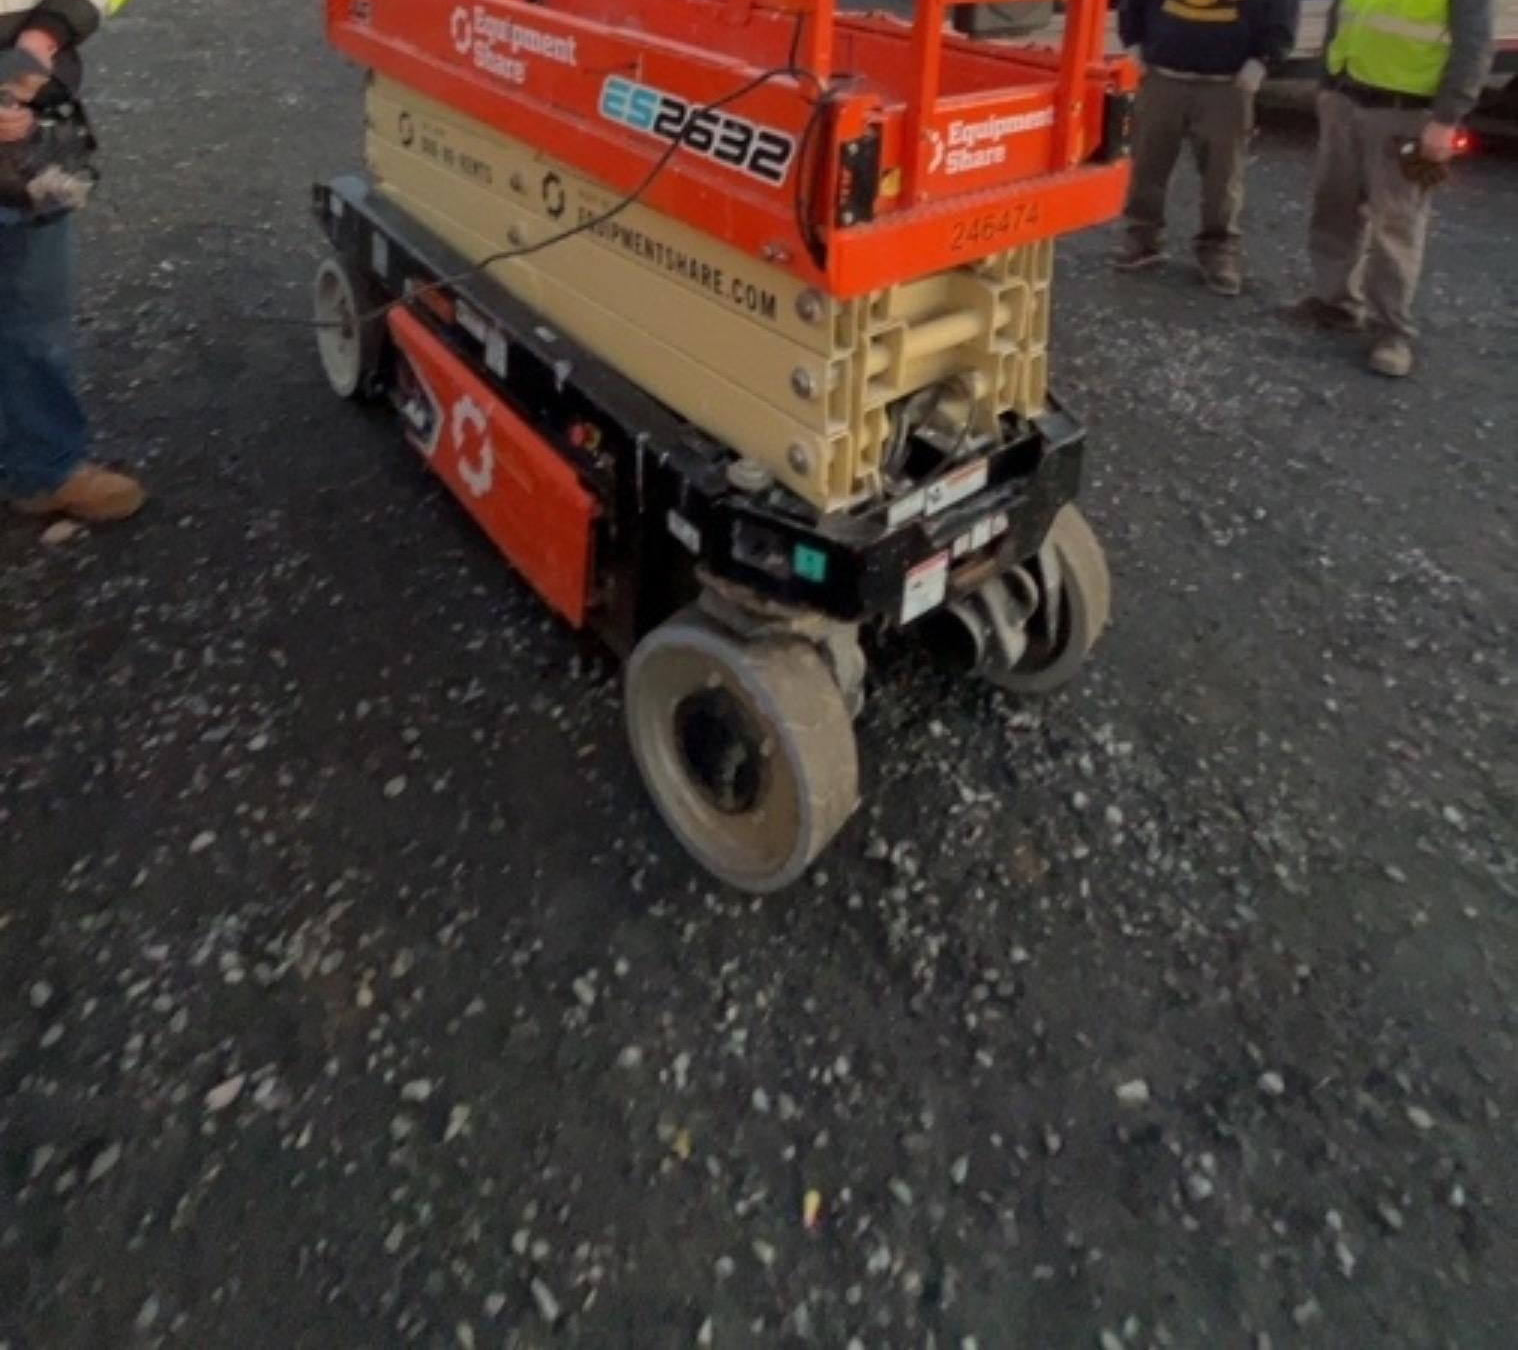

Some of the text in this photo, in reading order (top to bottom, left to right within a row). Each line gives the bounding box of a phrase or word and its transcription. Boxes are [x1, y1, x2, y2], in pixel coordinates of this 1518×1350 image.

[472, 5, 577, 67] Equipment
[472, 39, 526, 85] Share
[600, 76, 795, 184] ES2632
[946, 104, 1055, 147] Equipment
[945, 144, 1007, 175] Share
